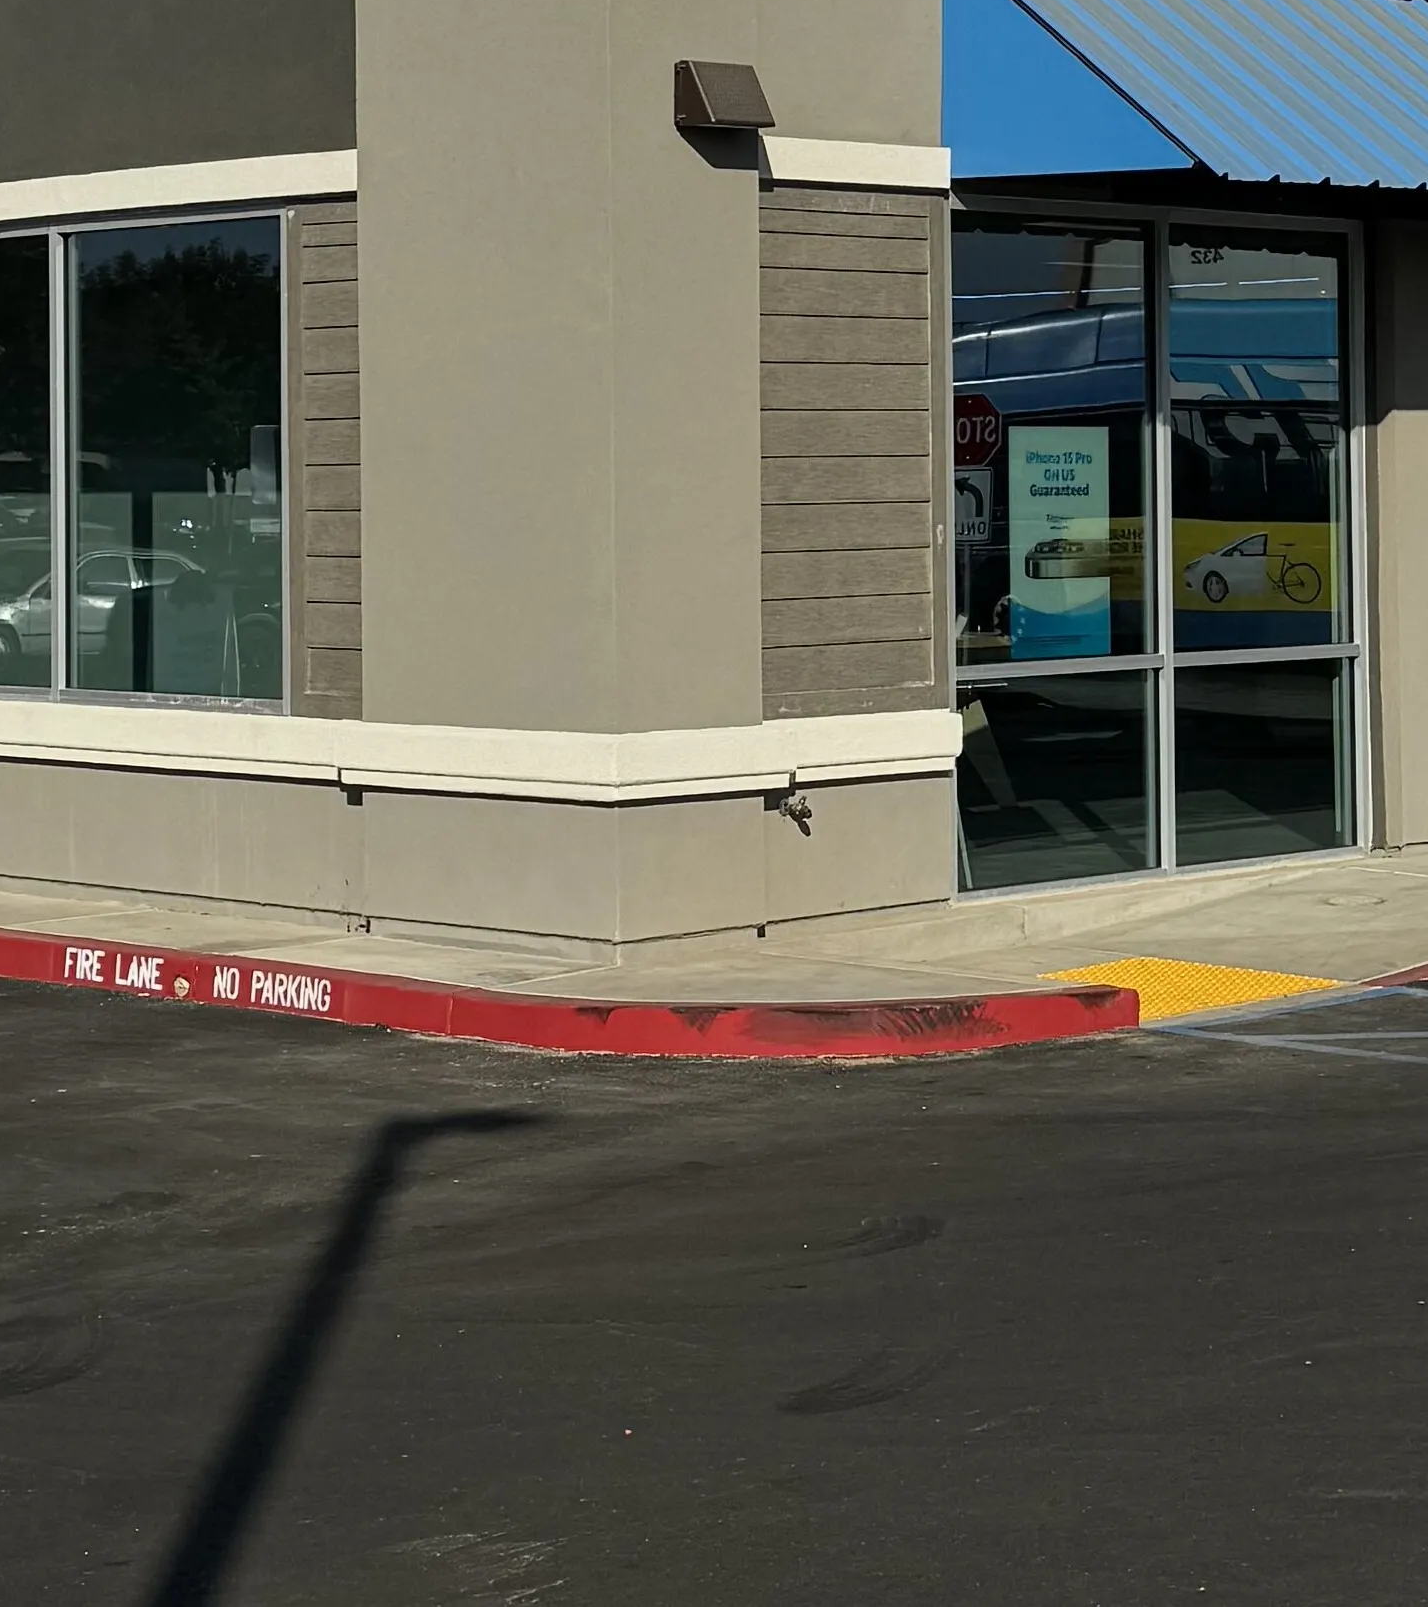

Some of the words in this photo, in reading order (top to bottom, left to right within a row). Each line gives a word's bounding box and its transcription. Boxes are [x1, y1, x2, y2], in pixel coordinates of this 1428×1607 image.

[1075, 452, 1092, 464] Pro
[1030, 483, 1089, 496] Guaranteed
[64, 947, 105, 982] FIRE
[115, 953, 164, 990] LANE
[213, 965, 240, 1000] NO
[250, 970, 331, 1012] PARKING
